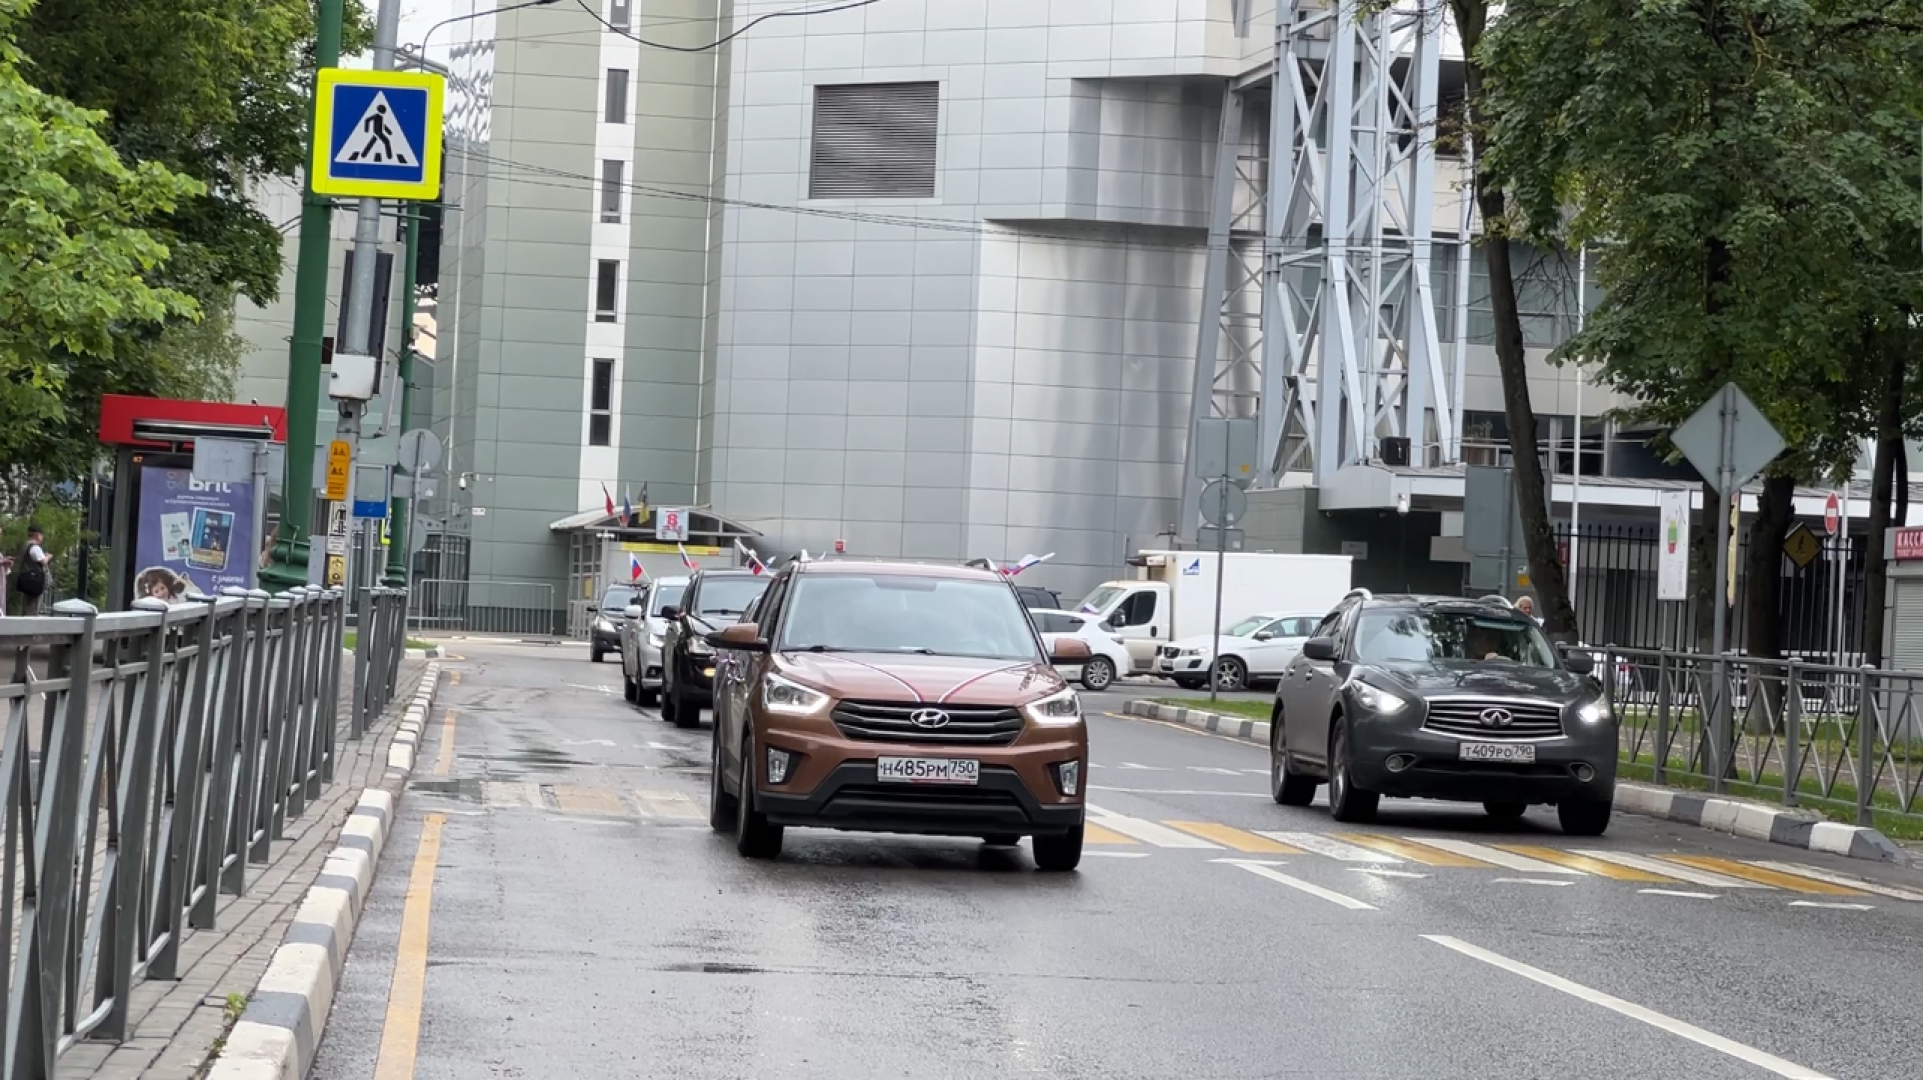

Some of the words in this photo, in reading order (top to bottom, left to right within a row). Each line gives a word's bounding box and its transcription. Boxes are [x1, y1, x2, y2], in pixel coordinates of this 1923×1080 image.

[667, 513, 678, 527] 8
[1465, 745, 1512, 758] Т409РО
[1513, 745, 1532, 756] 790
[883, 759, 947, 777] Н485РМ
[950, 760, 974, 773] 750
